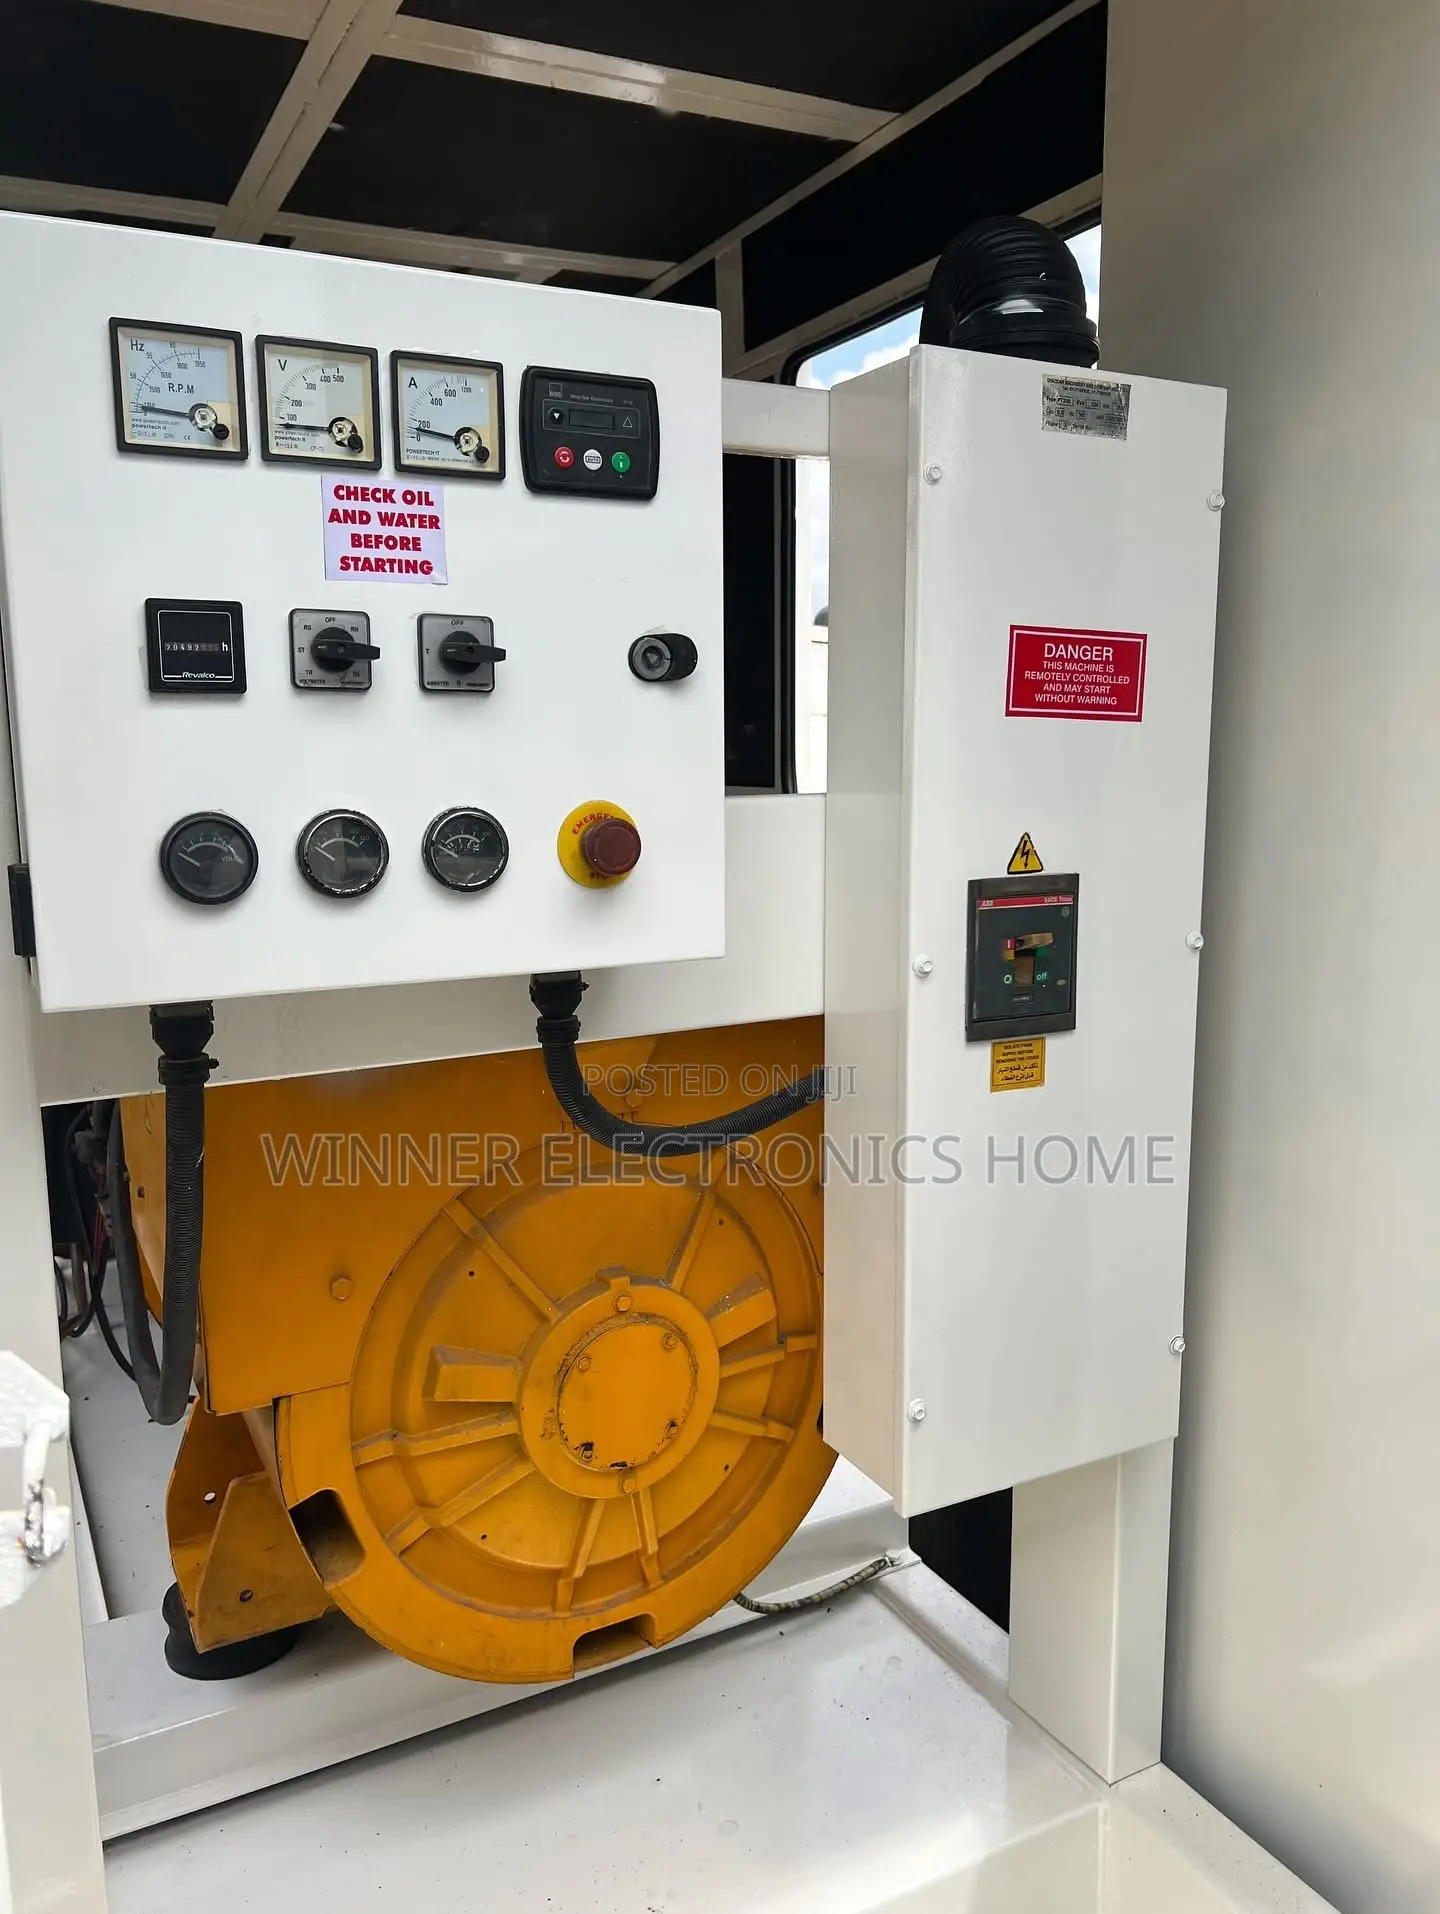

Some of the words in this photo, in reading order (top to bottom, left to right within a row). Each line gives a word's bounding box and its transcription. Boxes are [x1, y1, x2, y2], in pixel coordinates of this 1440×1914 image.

[130, 339, 145, 352] Hz
[146, 352, 153, 360] 55
[278, 359, 288, 371] V
[130, 372, 137, 380] 50
[320, 375, 331, 383] 400
[332, 374, 344, 383] 500
[168, 382, 195, 394] R.P.M
[305, 382, 317, 390] 300
[408, 377, 418, 389] A
[149, 385, 160, 394] 1500
[444, 388, 457, 398] 600
[291, 399, 302, 407] 200
[430, 398, 443, 406] 400
[287, 413, 297, 421] 100
[418, 420, 430, 429] 200
[333, 484, 396, 504] CHECK
[402, 490, 434, 506] OIL
[328, 508, 371, 525] AND
[377, 511, 441, 530] WATER
[350, 533, 422, 552] BEFORE
[340, 555, 433, 575] STARTING
[222, 642, 228, 652] h
[1044, 643, 1114, 661] DANGER
[1043, 661, 1062, 670] THIS
[1064, 662, 1104, 672] MACHINE
[1106, 664, 1114, 673] IS
[182, 671, 215, 679] Revalco
[1024, 671, 1071, 681] REMOTELY
[1072, 673, 1129, 684] CONTROLLED
[1043, 683, 1062, 692] AND
[1064, 684, 1082, 693] MAY
[1084, 685, 1111, 694] START
[1035, 693, 1075, 703] WITHOUT
[1077, 695, 1117, 705] WARNING
[1036, 972, 1047, 981] off
